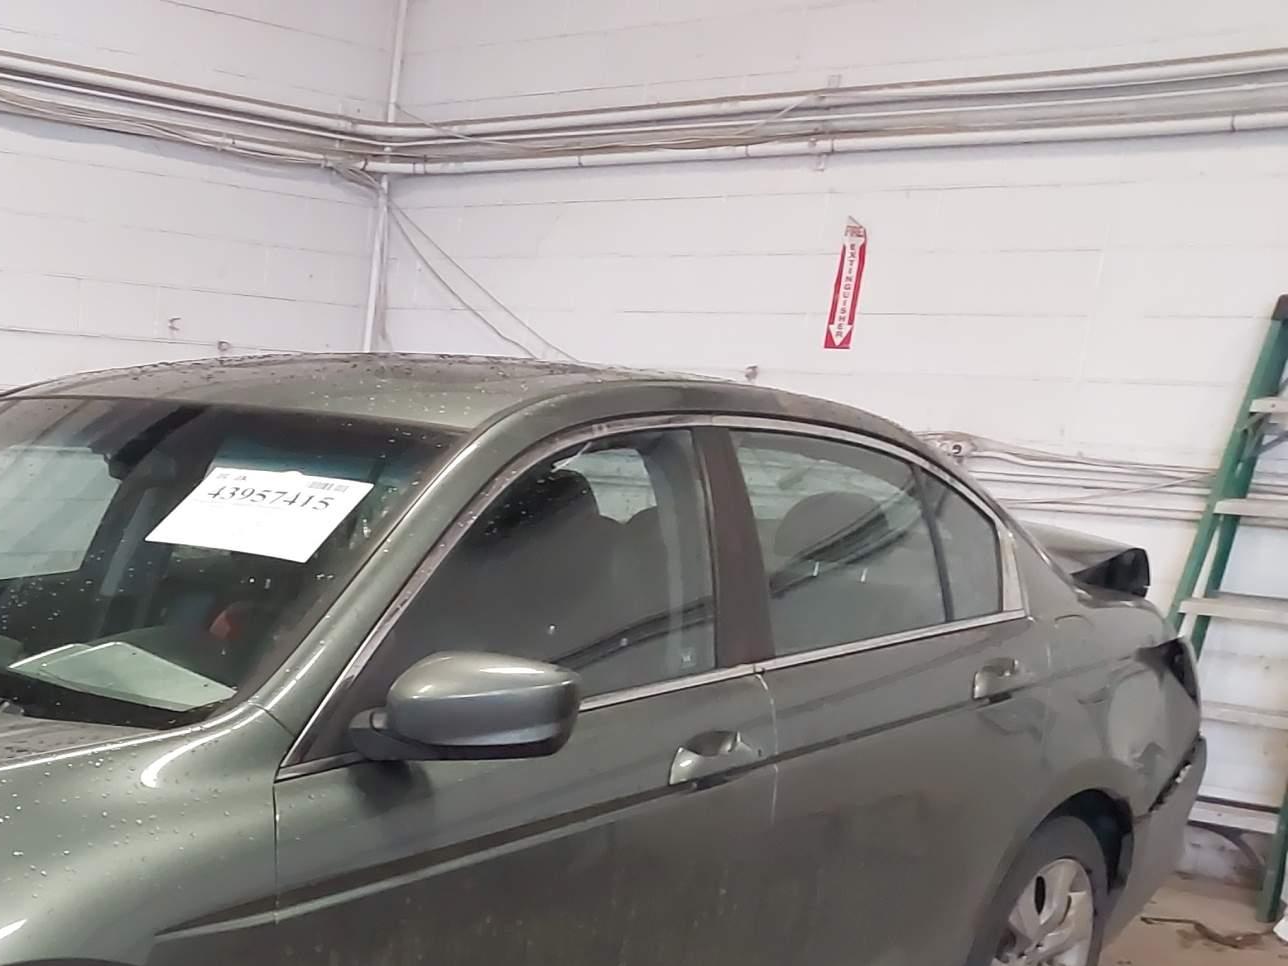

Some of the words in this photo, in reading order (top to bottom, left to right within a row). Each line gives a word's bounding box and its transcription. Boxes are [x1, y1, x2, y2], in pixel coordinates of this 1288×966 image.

[844, 225, 865, 238] FIRE
[834, 243, 856, 338] EXTINGUISHER
[207, 485, 336, 511] 43957415
